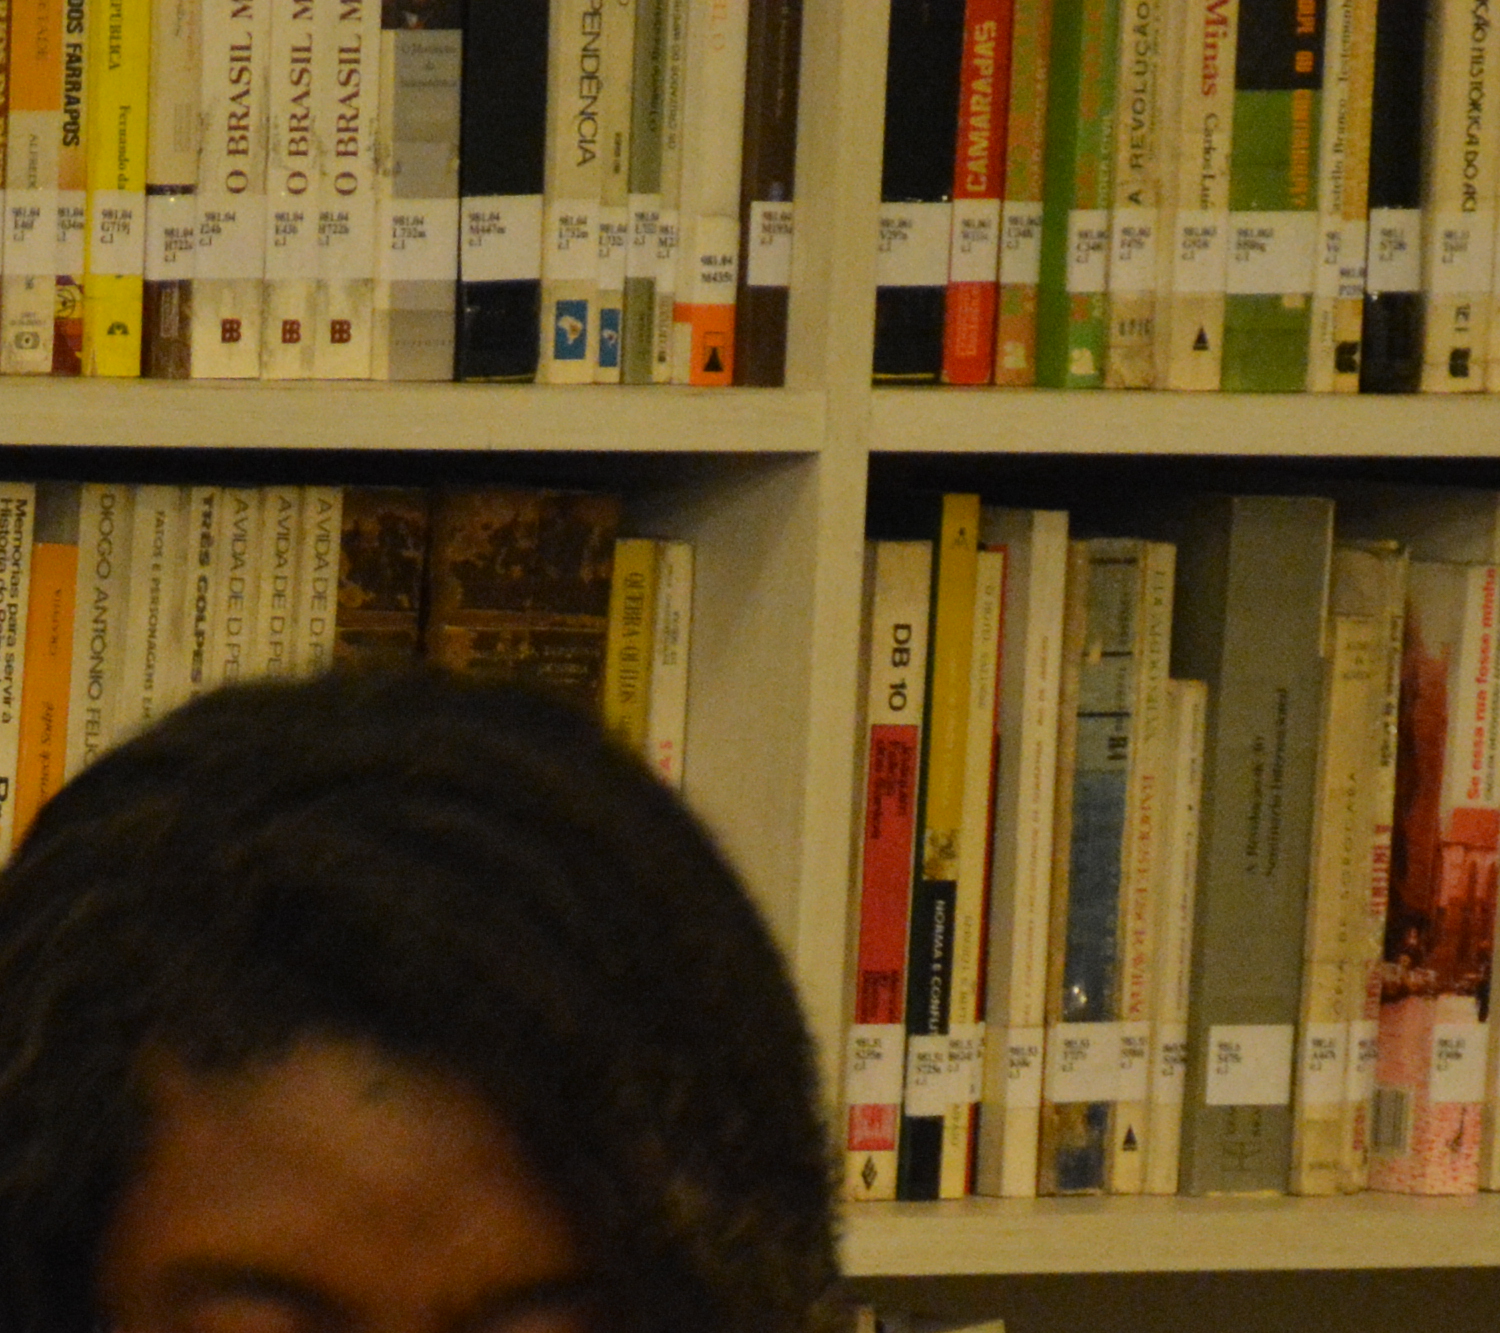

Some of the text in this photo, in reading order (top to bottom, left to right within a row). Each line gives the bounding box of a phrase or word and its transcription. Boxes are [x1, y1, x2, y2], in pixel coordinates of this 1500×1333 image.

[62, 43, 84, 148] FARRAPOS
[226, 32, 253, 194] O BRASIL
[286, 33, 313, 195] O BRASIL
[335, 33, 362, 196] O BRASIL
[1129, 2, 1151, 169] REVOLUÇÃO
[1200, 0, 1230, 171] Minas Carlos
[232, 498, 250, 515] A
[276, 497, 294, 513] A
[317, 499, 333, 515] A
[229, 515, 249, 573] VIDA
[273, 514, 294, 571] VIDA
[312, 515, 333, 572] VIDA
[191, 492, 218, 684] TRÊS GOLPES
[227, 576, 246, 612] DE
[272, 574, 290, 610] DE
[311, 576, 330, 612] DE
[0, 602, 20, 648] para
[0, 651, 18, 708] servir
[889, 622, 912, 712] DB 10
[1466, 568, 1497, 801] Se essa rua fosse minha
[931, 898, 948, 960] NORMA
[928, 975, 946, 1036] CONFLI
